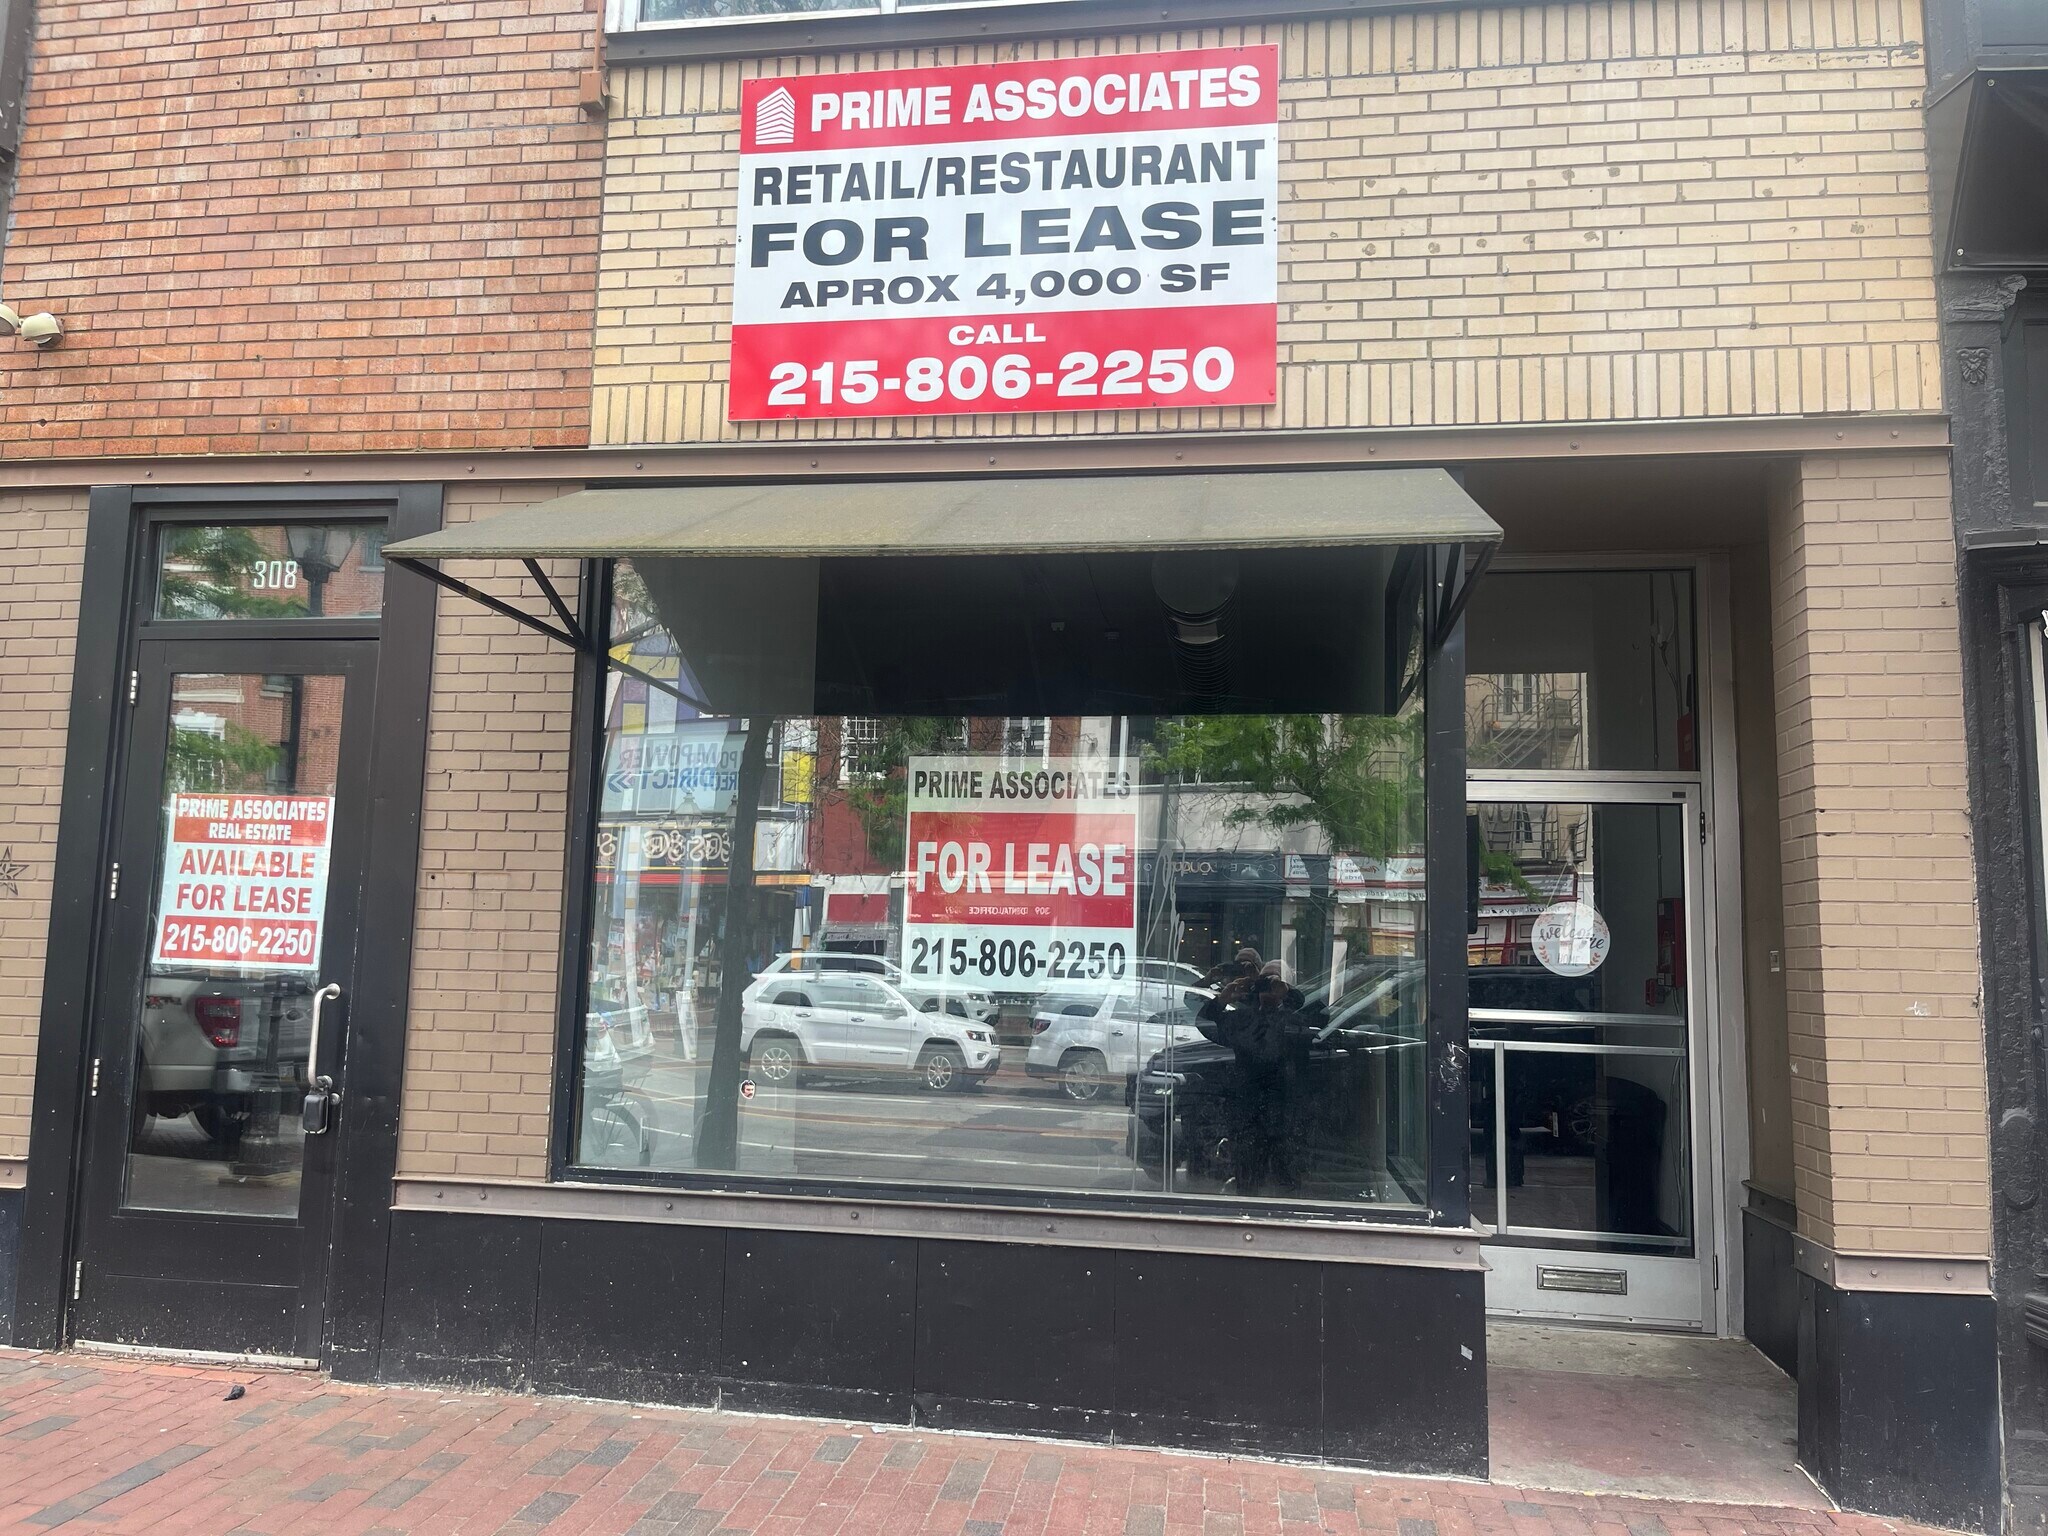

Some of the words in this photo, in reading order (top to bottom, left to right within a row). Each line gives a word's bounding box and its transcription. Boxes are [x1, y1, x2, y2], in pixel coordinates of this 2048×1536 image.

[811, 85, 952, 131] PRIME
[963, 66, 1260, 123] ASSOCIATES
[754, 139, 1265, 206] RETAIL/RESTAURANT
[751, 216, 929, 268] FOR
[964, 199, 1264, 258] LEASE
[780, 274, 960, 309] APROX
[977, 266, 1141, 305] 4,000
[1160, 262, 1229, 292] SF
[948, 323, 1046, 345] CALL
[768, 346, 1235, 406] 215-806-2250
[253, 560, 298, 590] 308
[914, 770, 982, 799] PRIME
[989, 771, 1131, 800] ASSOCIATES
[178, 798, 228, 818] PRIME
[233, 801, 326, 821] ASSOCIATES
[209, 822, 241, 840] REAL
[245, 824, 291, 841] ESTATE
[179, 848, 314, 879] AVAILABLE
[916, 841, 992, 894] FOR
[1004, 842, 1126, 896] LEASE
[176, 883, 225, 911] FOR
[234, 885, 312, 914] LEASE
[165, 923, 312, 957] 215-806-2250
[910, 938, 1126, 980] 215-806-2250
